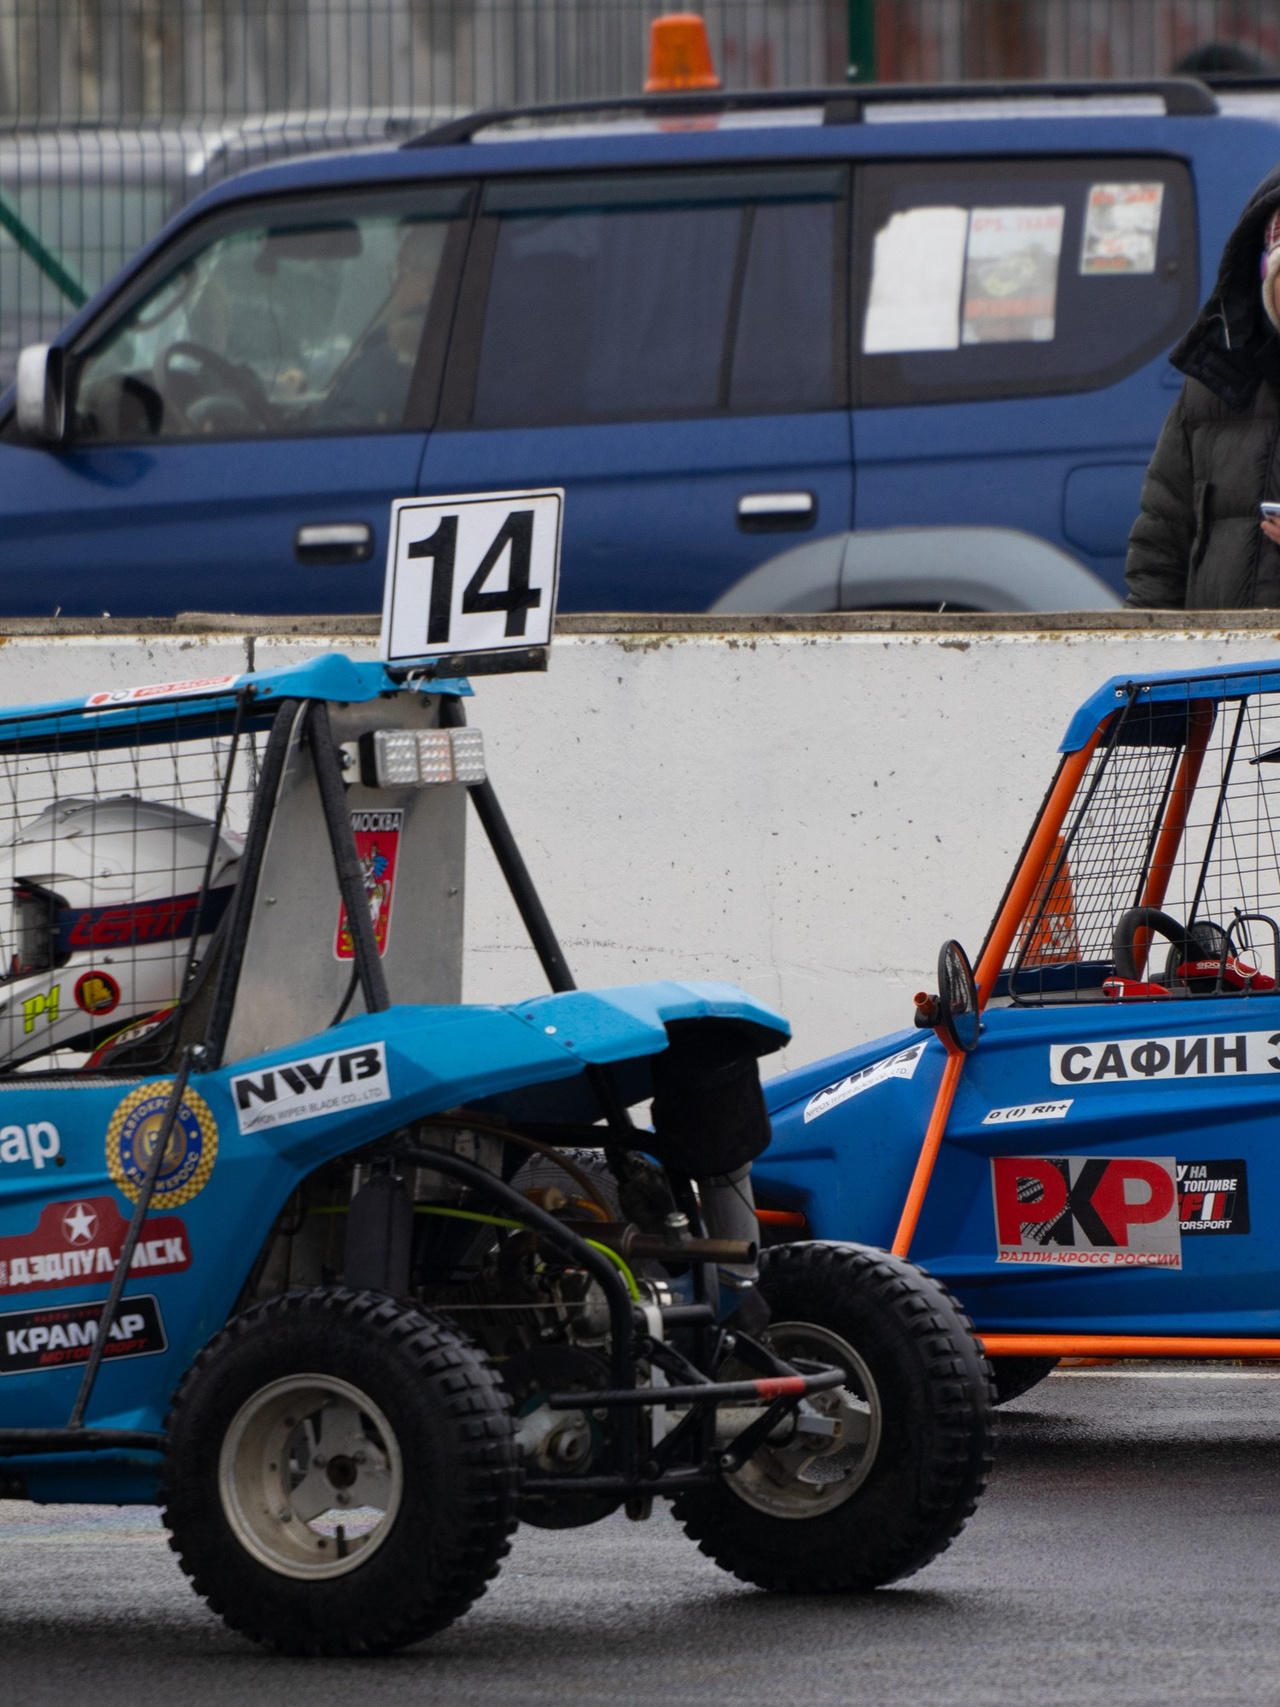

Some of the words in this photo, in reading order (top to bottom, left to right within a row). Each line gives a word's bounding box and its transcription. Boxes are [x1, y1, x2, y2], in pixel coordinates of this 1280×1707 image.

[408, 510, 541, 644] 14
[350, 813, 399, 832] МОСКВА
[1060, 1035, 1248, 1082] САФИН
[235, 1048, 382, 1110] NWB
[1189, 1165, 1208, 1179] НА
[1183, 1178, 1238, 1193] ТОПЛИВЕ
[1000, 1250, 1110, 1264] РАЛЛИ-КРОСС
[1113, 1253, 1180, 1266] РОССИИ
[39, 1338, 149, 1364] МОТОРПОРТ
